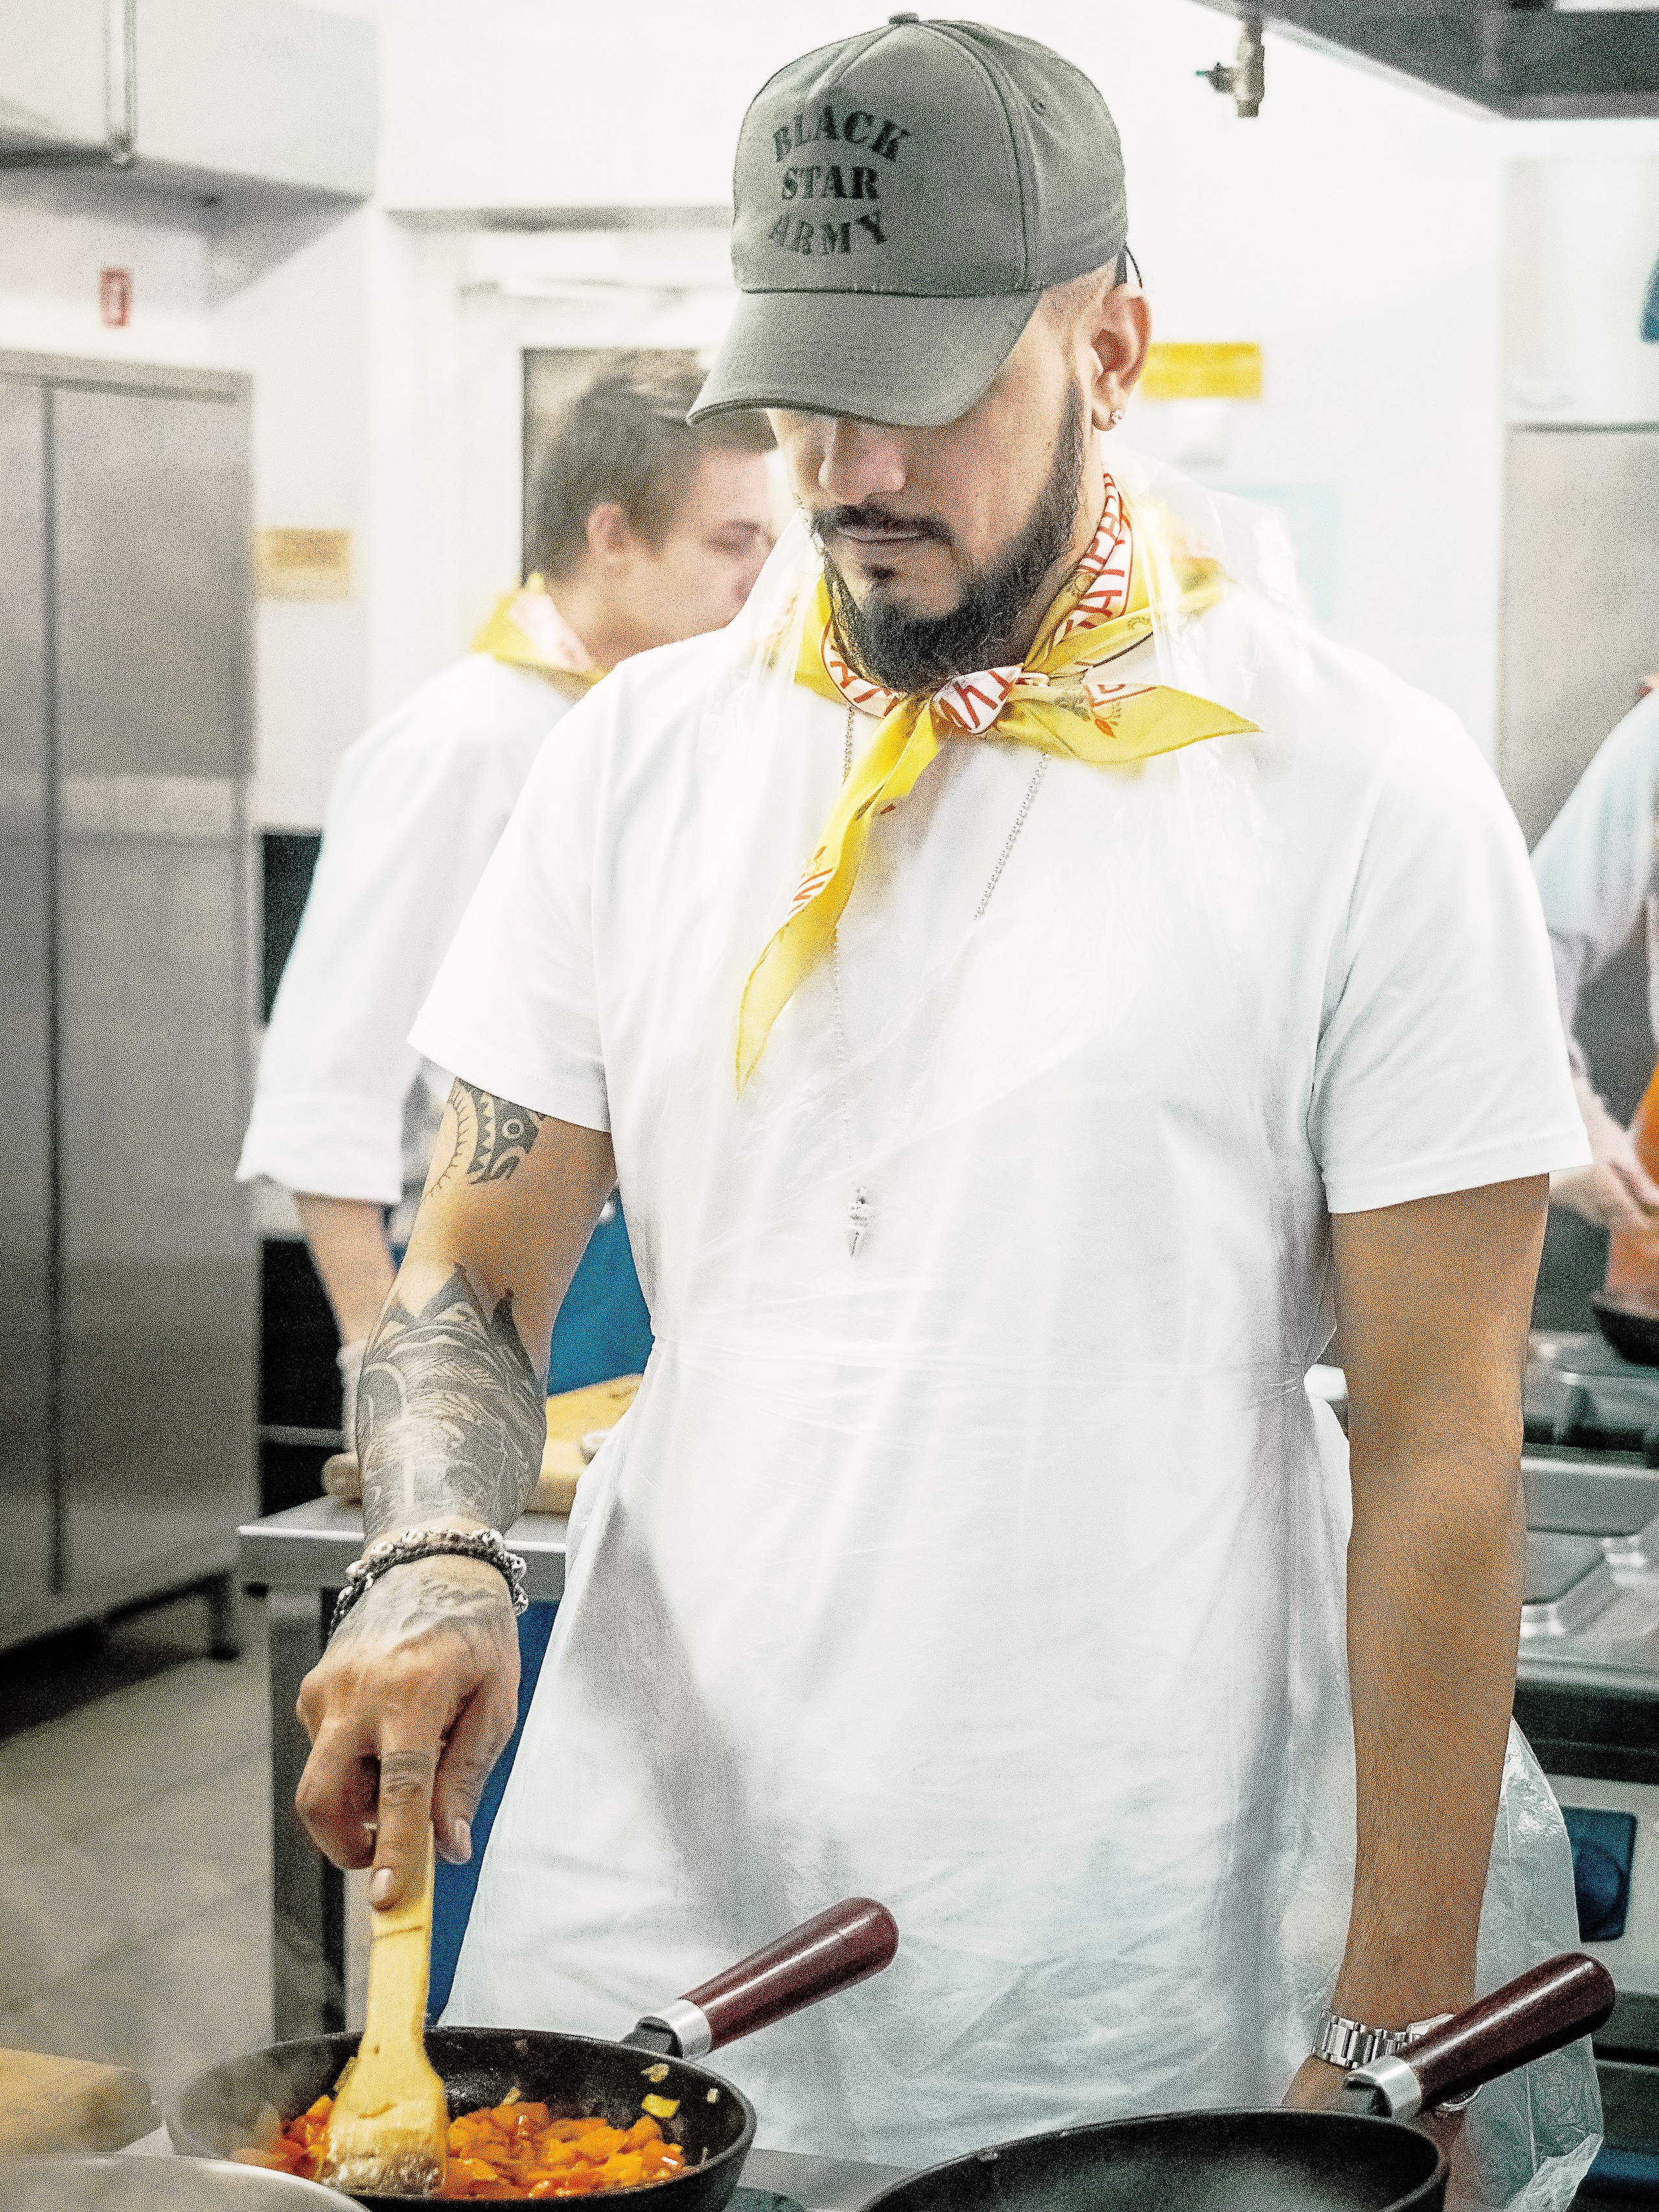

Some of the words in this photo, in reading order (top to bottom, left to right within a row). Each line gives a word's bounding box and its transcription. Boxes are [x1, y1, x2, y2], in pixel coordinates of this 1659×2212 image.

[773, 104, 910, 162] BLACK
[782, 165, 879, 200] STAR
[769, 210, 887, 255] ARMY
